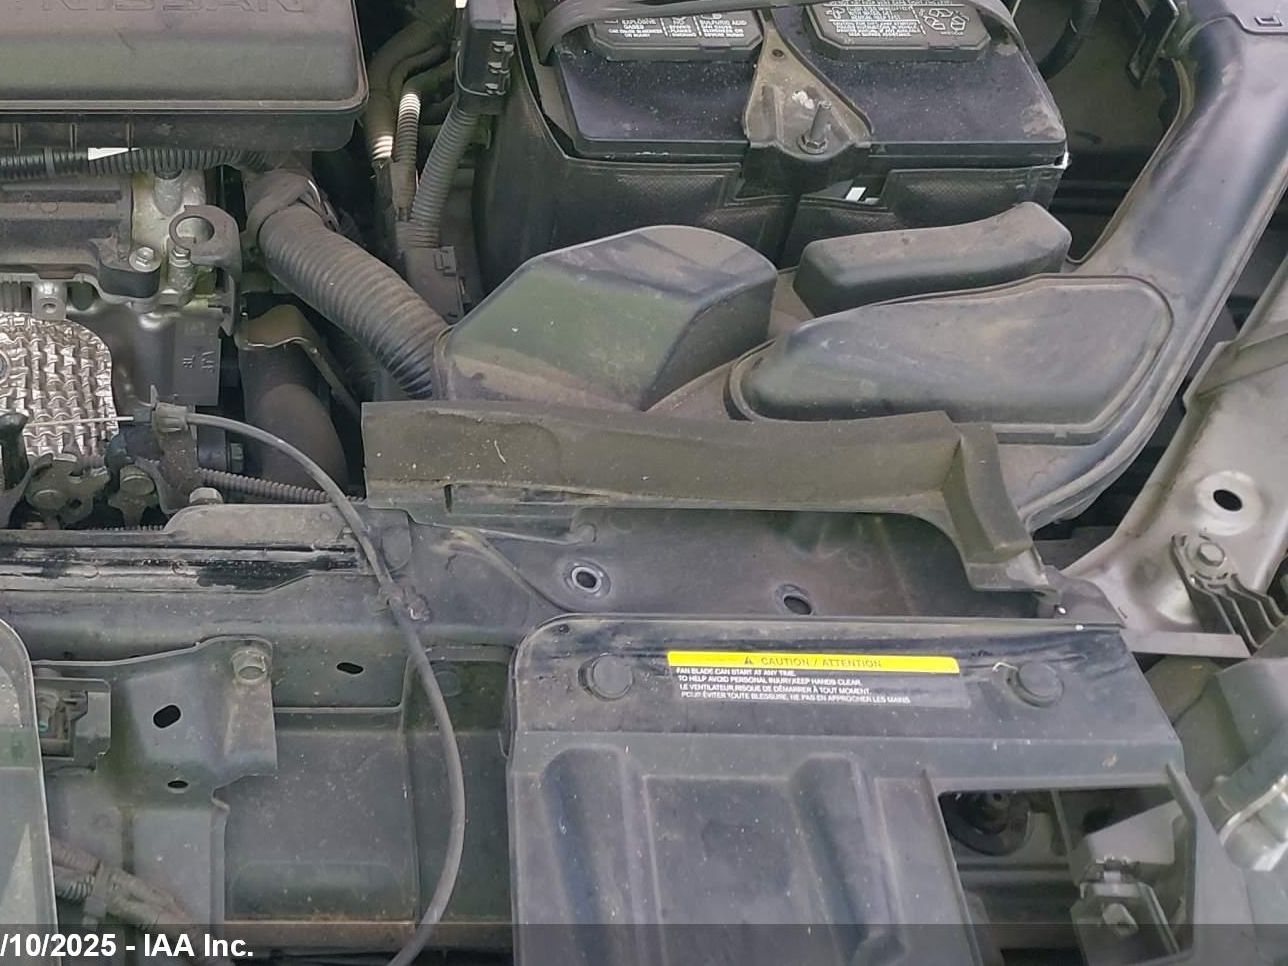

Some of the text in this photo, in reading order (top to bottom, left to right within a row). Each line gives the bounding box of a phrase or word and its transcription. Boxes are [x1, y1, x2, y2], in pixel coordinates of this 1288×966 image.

[761, 657, 809, 667] CAUTION
[822, 658, 882, 668] ATTENTION
[691, 667, 713, 675] BLADE
[732, 668, 752, 676] START
[678, 674, 688, 682] TO
[708, 675, 729, 683] AVOID
[730, 676, 767, 684] PERSONAL
[811, 678, 836, 686] HANDS
[679, 683, 689, 691] LE
[820, 686, 838, 694] TOUT
